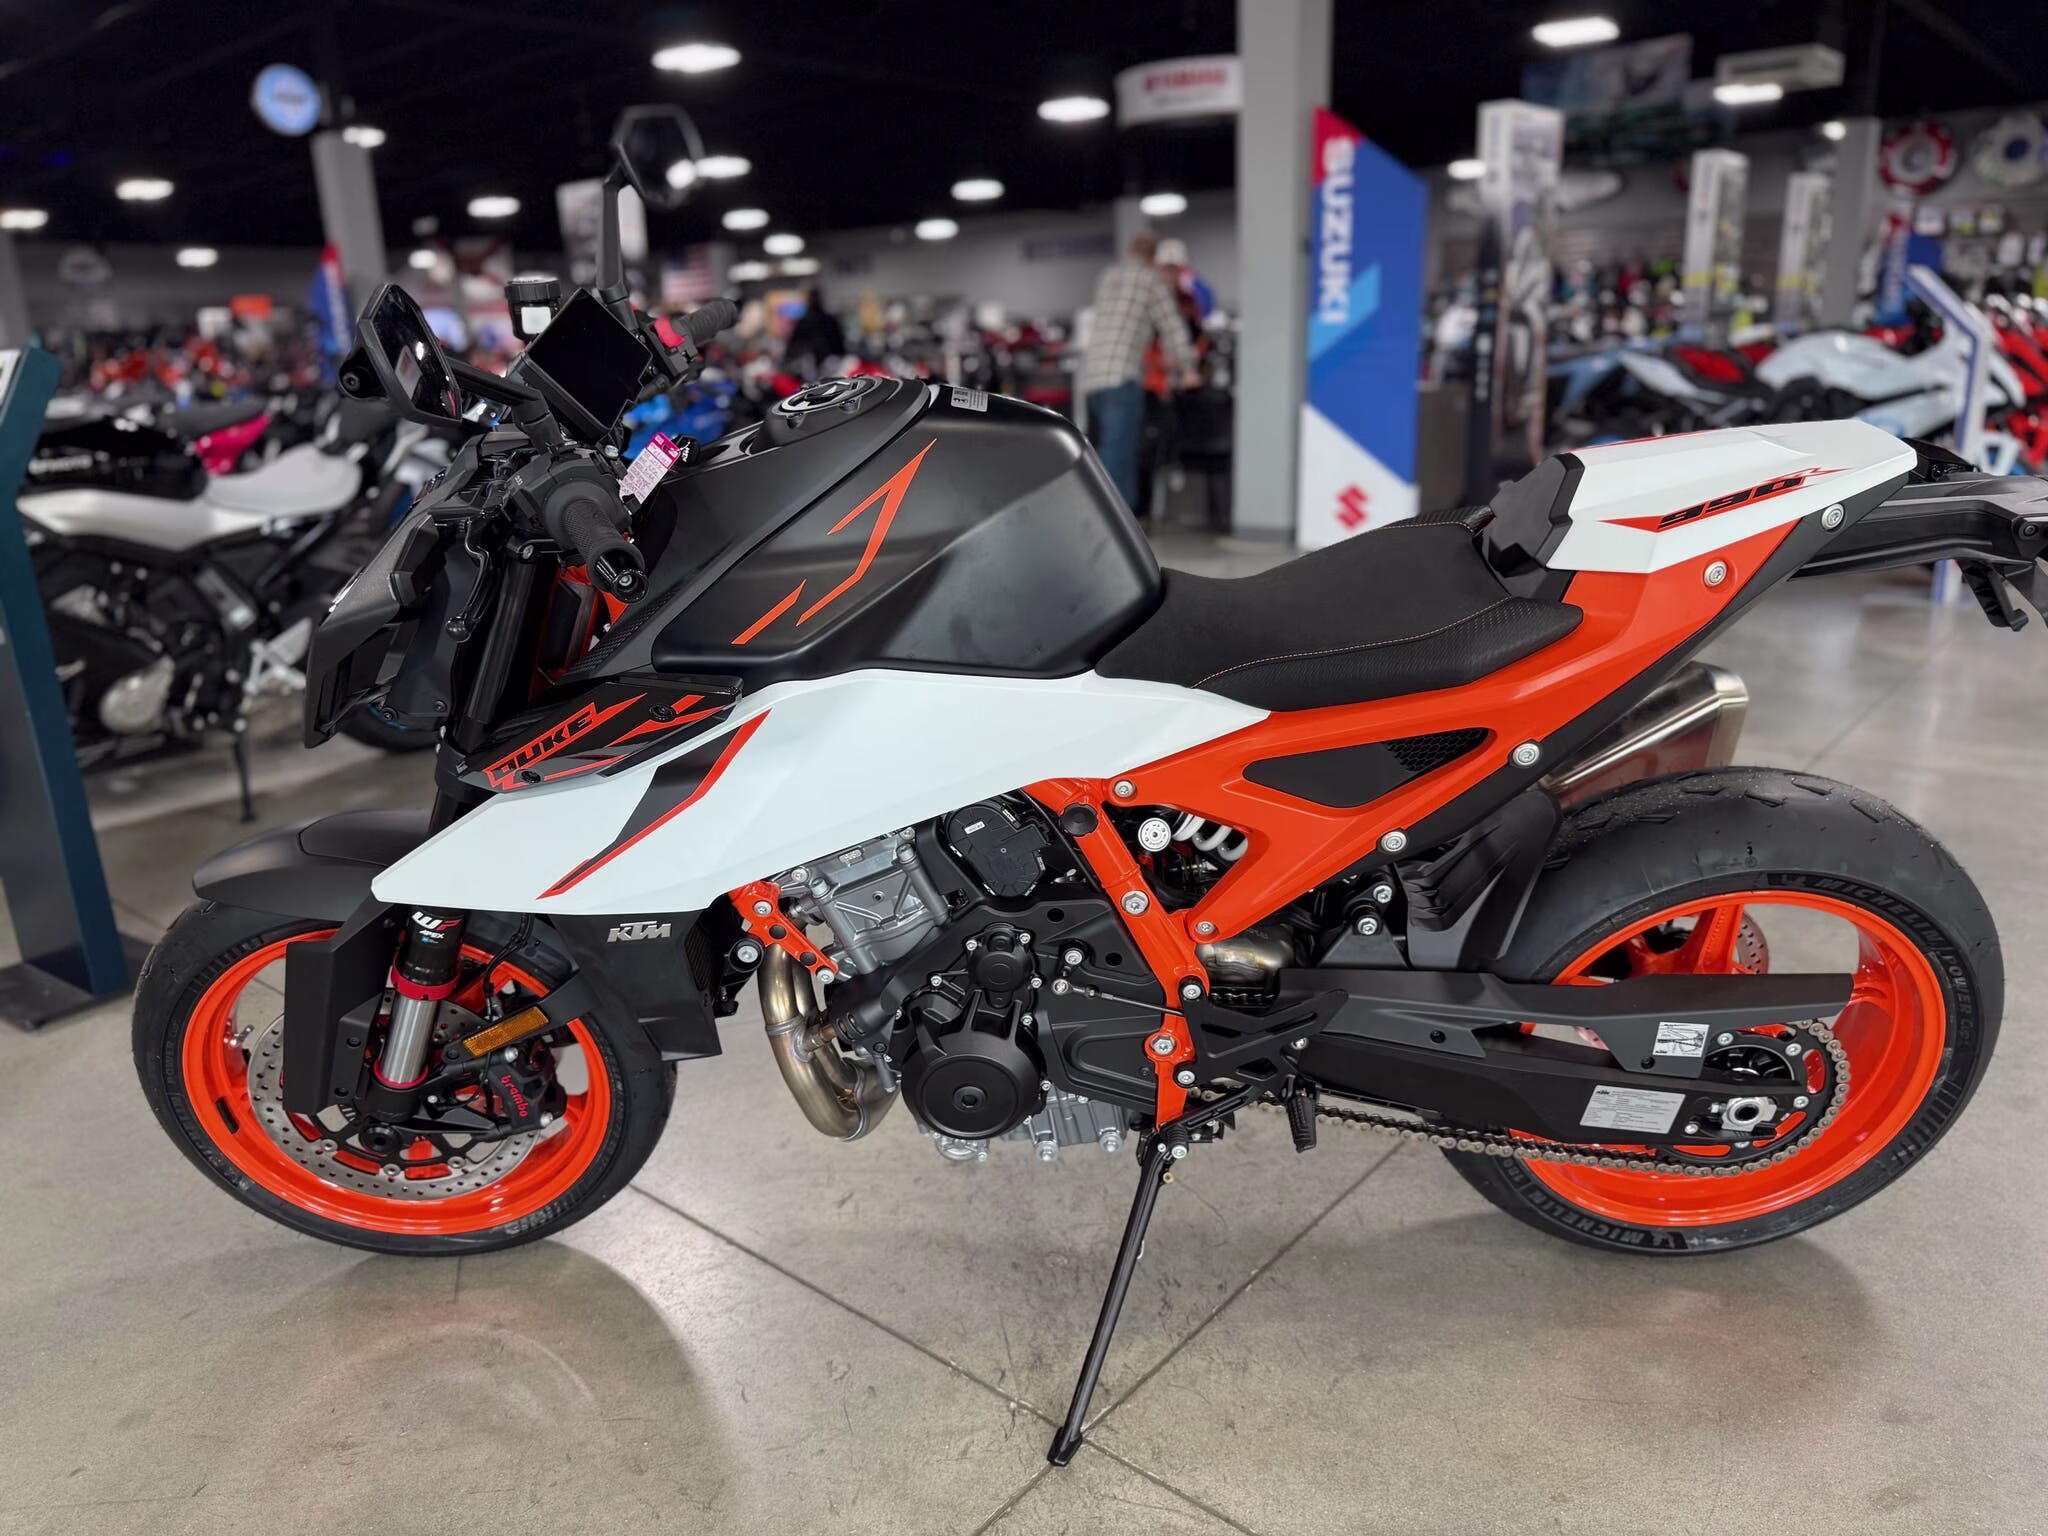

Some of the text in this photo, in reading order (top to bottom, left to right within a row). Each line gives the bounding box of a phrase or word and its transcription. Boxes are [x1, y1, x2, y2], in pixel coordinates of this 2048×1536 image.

[1320, 136, 1355, 325] SUZUKI
[1657, 476, 1805, 530] 990
[491, 710, 592, 780] DUKE
[412, 911, 463, 931] WP
[607, 921, 671, 943] KTM
[1814, 877, 1944, 949] MICHELIN
[1943, 952, 1973, 1015] POWER
[500, 1074, 529, 1118] brembo
[1526, 1190, 1646, 1245] MICHELIN
